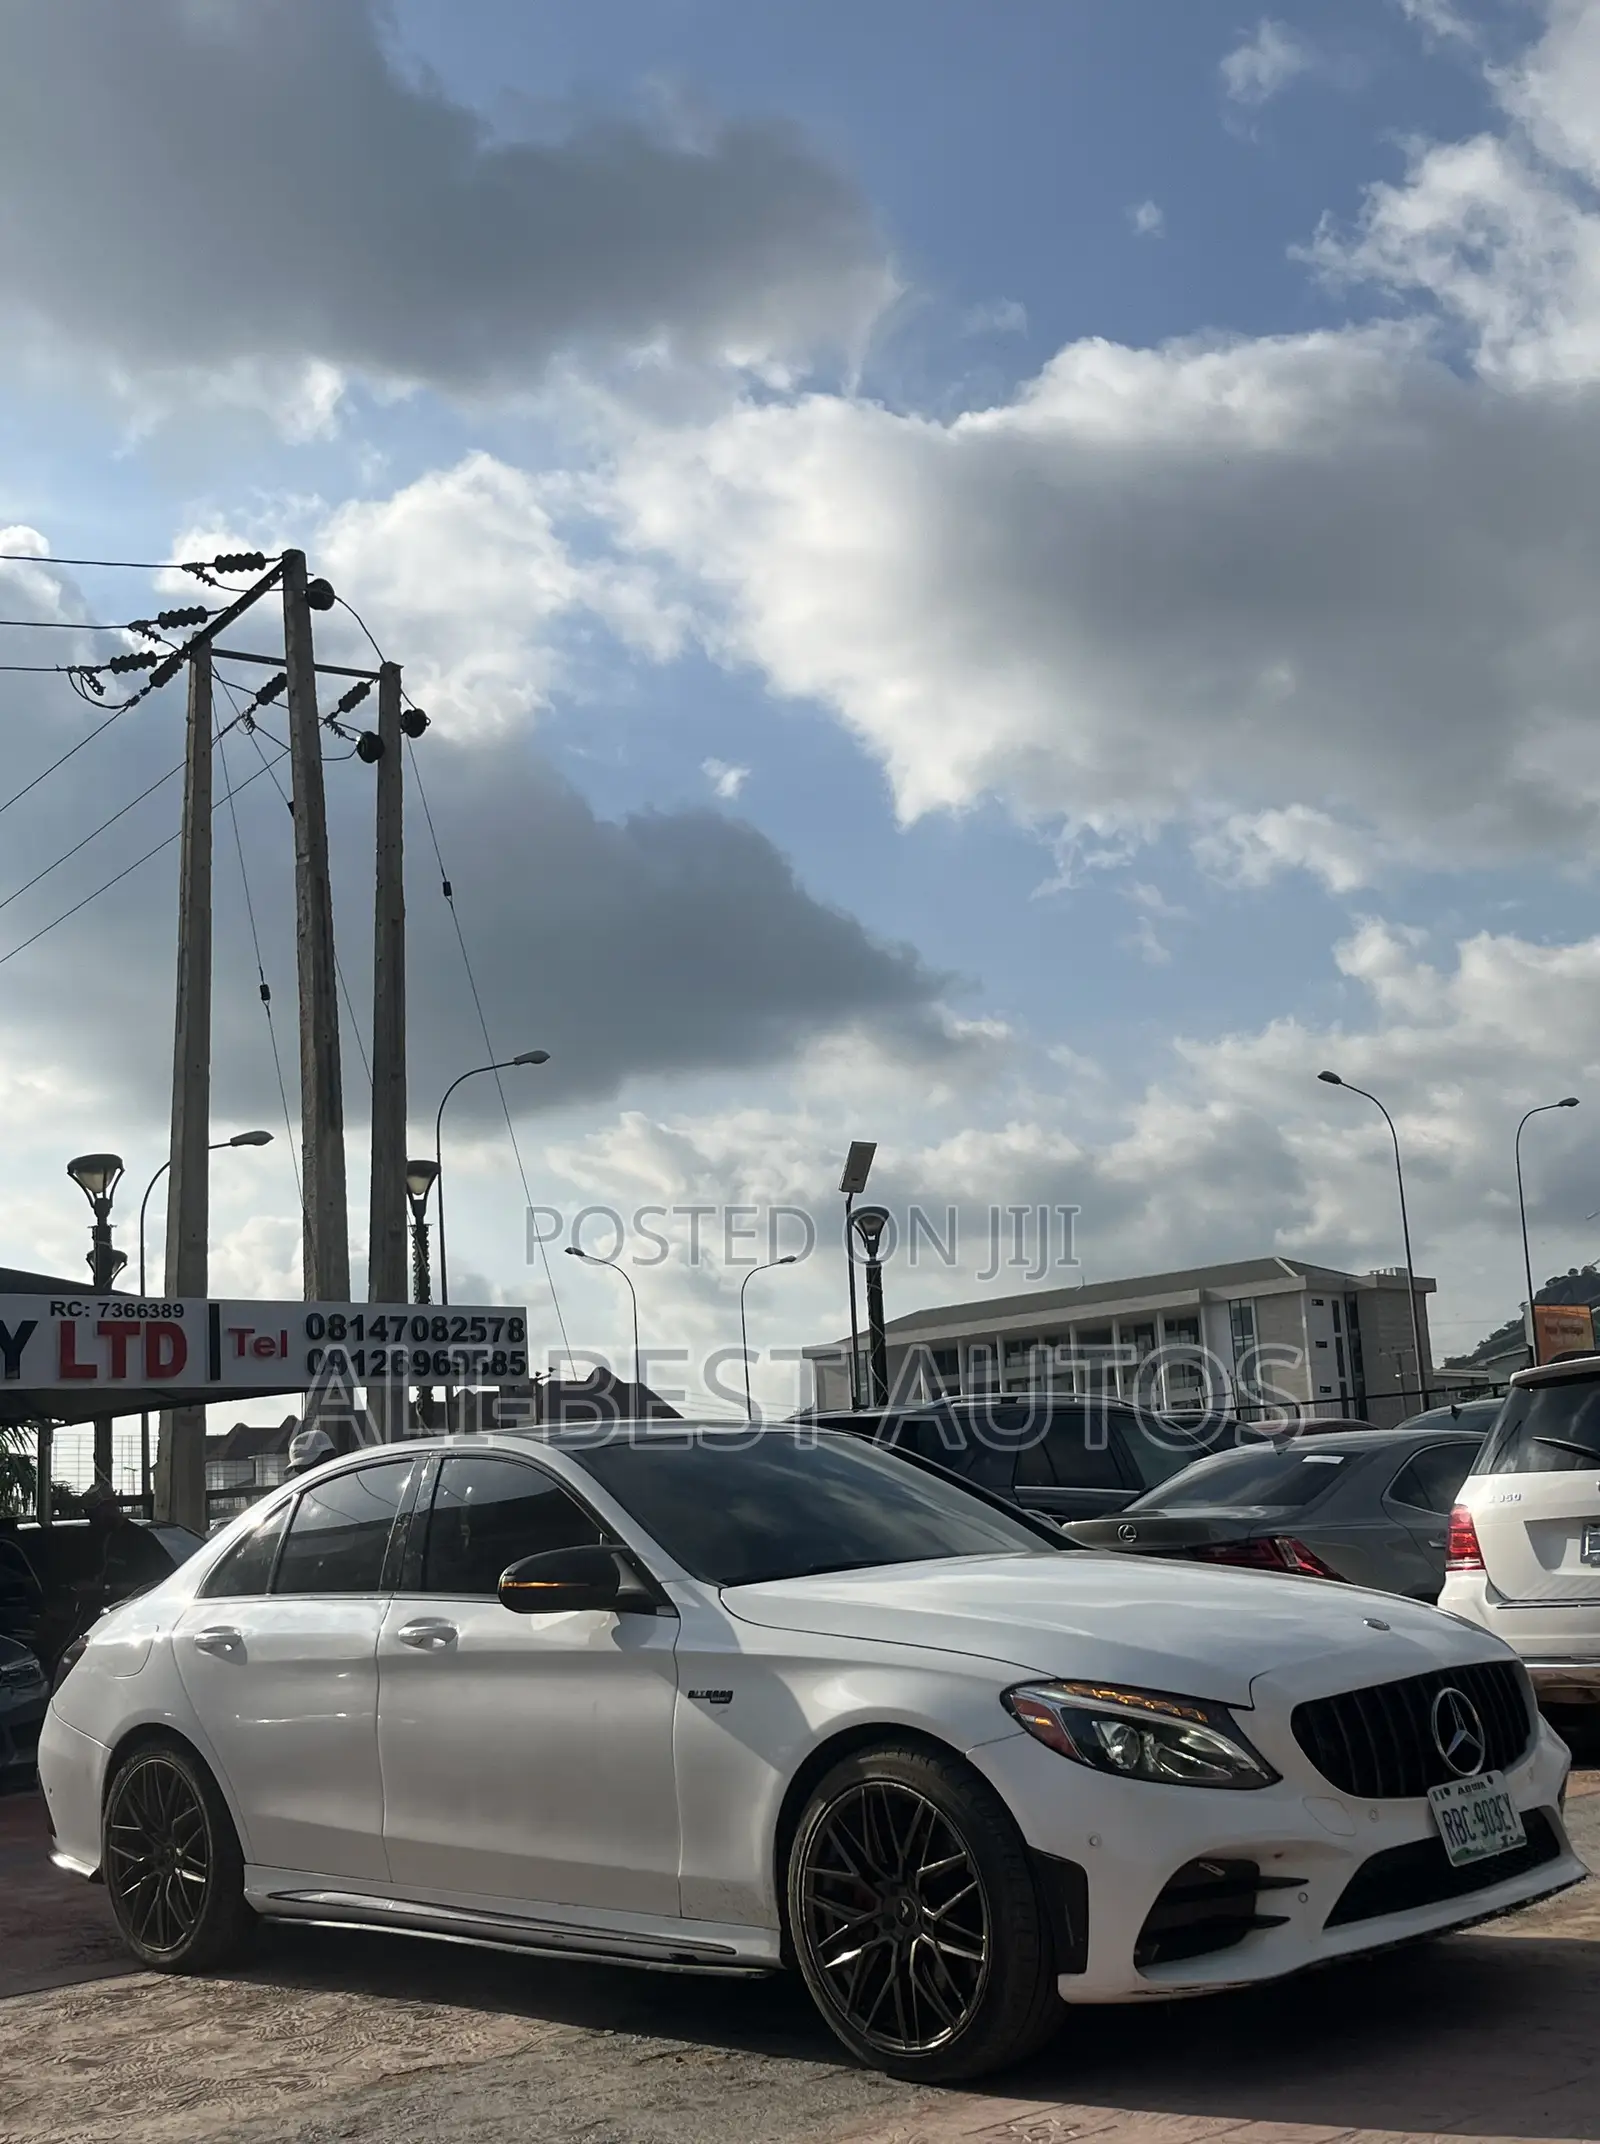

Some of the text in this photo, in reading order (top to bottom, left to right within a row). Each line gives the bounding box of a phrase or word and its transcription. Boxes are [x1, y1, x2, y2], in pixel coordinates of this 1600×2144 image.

[50, 1301, 185, 1319] RC: 7366389
[228, 1327, 288, 1359] Tel
[306, 1312, 525, 1343] 08147082578
[59, 1320, 188, 1380] LTD
[306, 1347, 527, 1378] 09126969585
